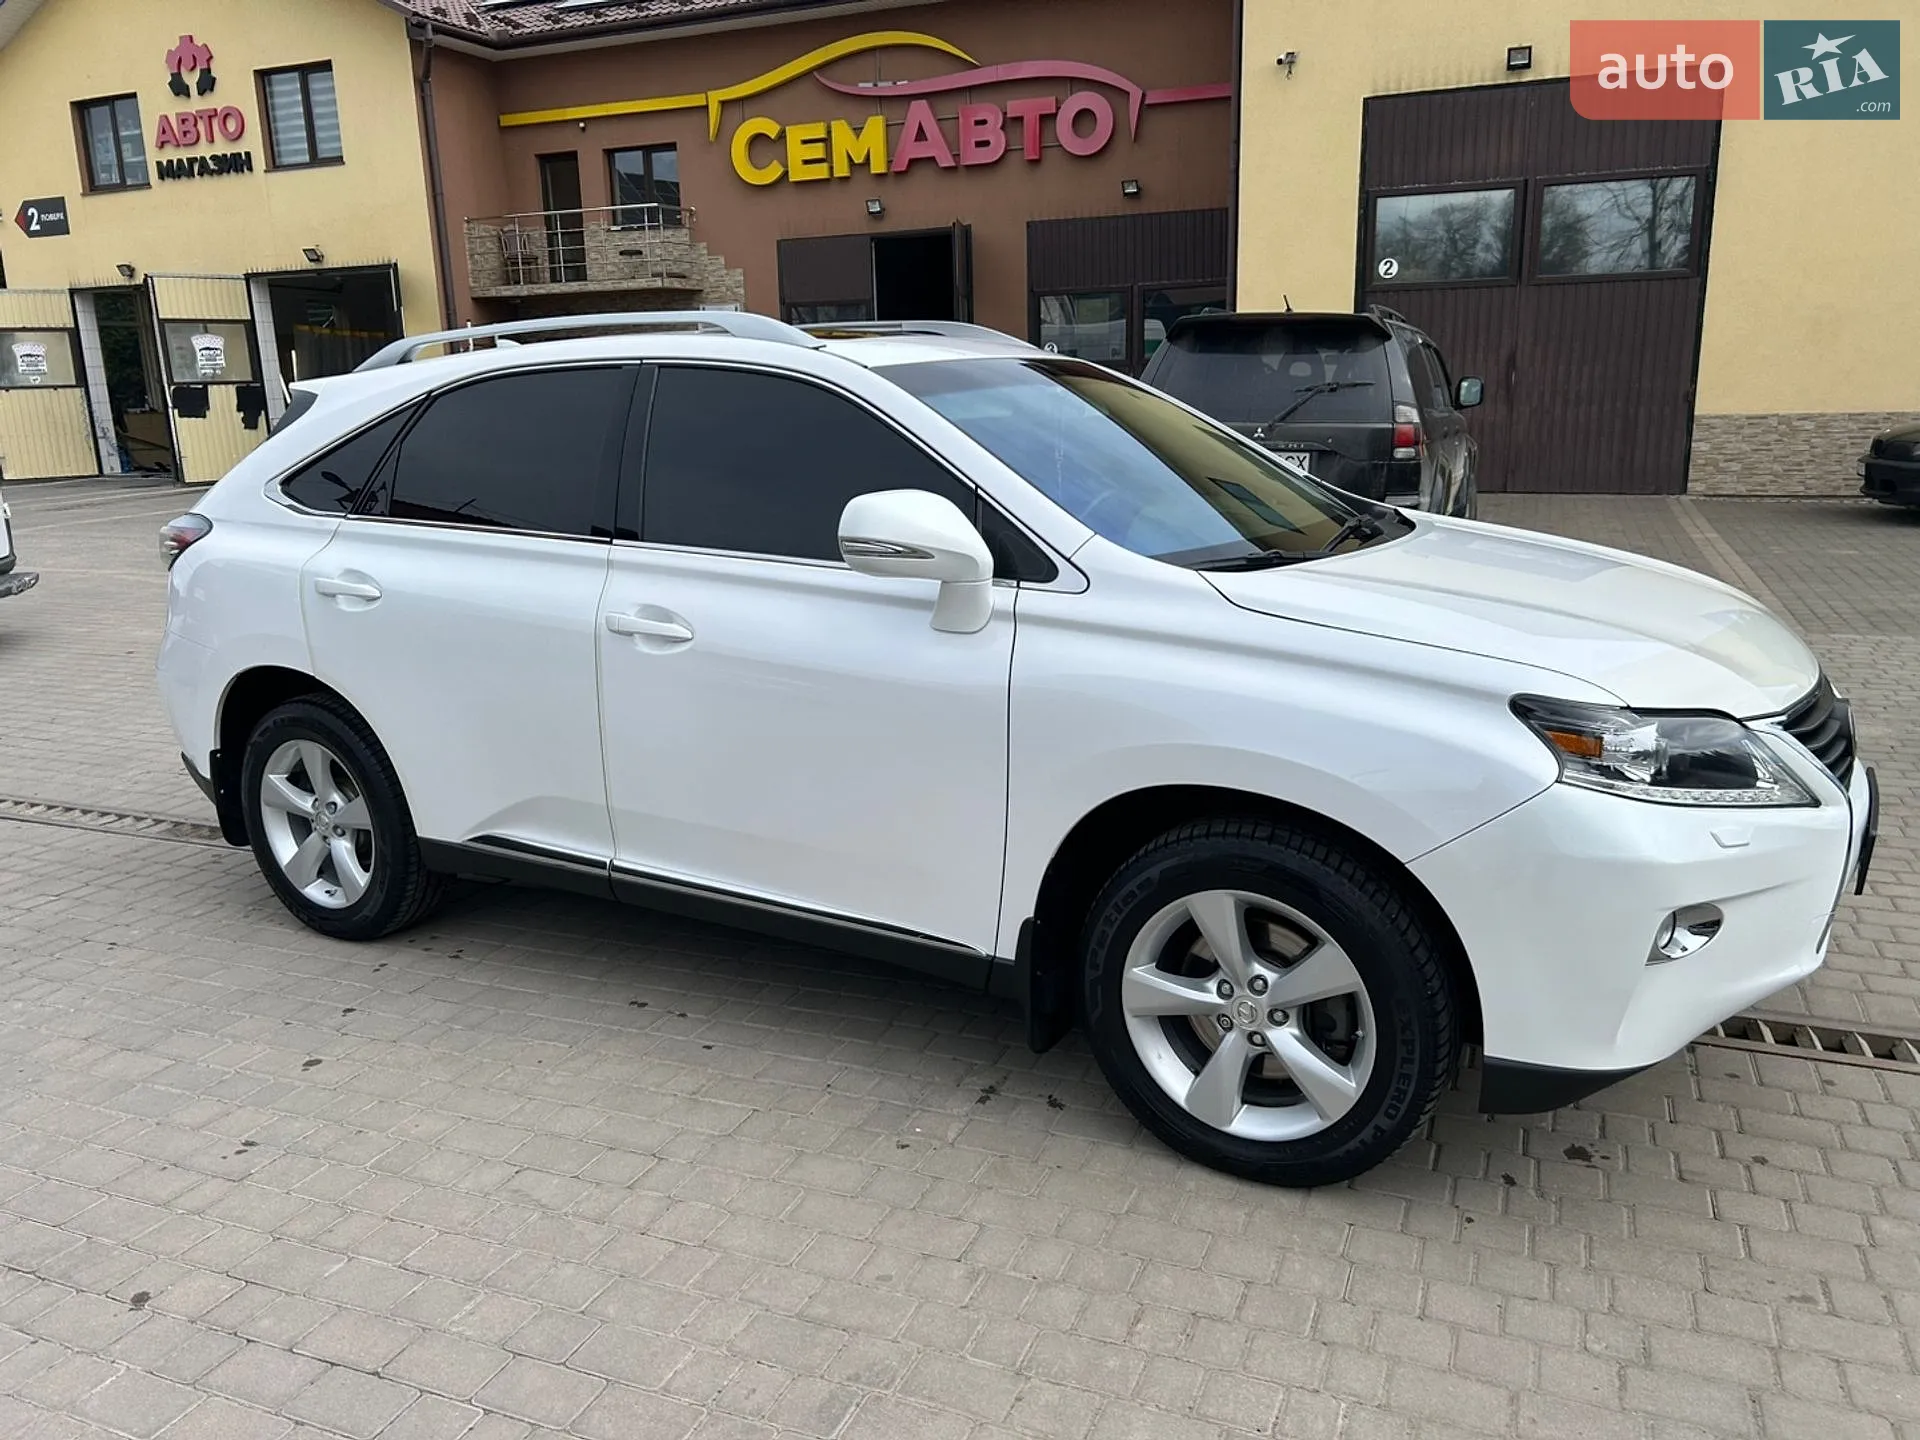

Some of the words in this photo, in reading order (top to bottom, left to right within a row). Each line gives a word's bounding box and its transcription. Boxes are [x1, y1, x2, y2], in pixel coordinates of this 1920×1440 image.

[155, 106, 245, 149] АВТО
[155, 151, 254, 181] МАГАЗИН
[27, 207, 41, 231] 2
[1383, 260, 1394, 276] 2
